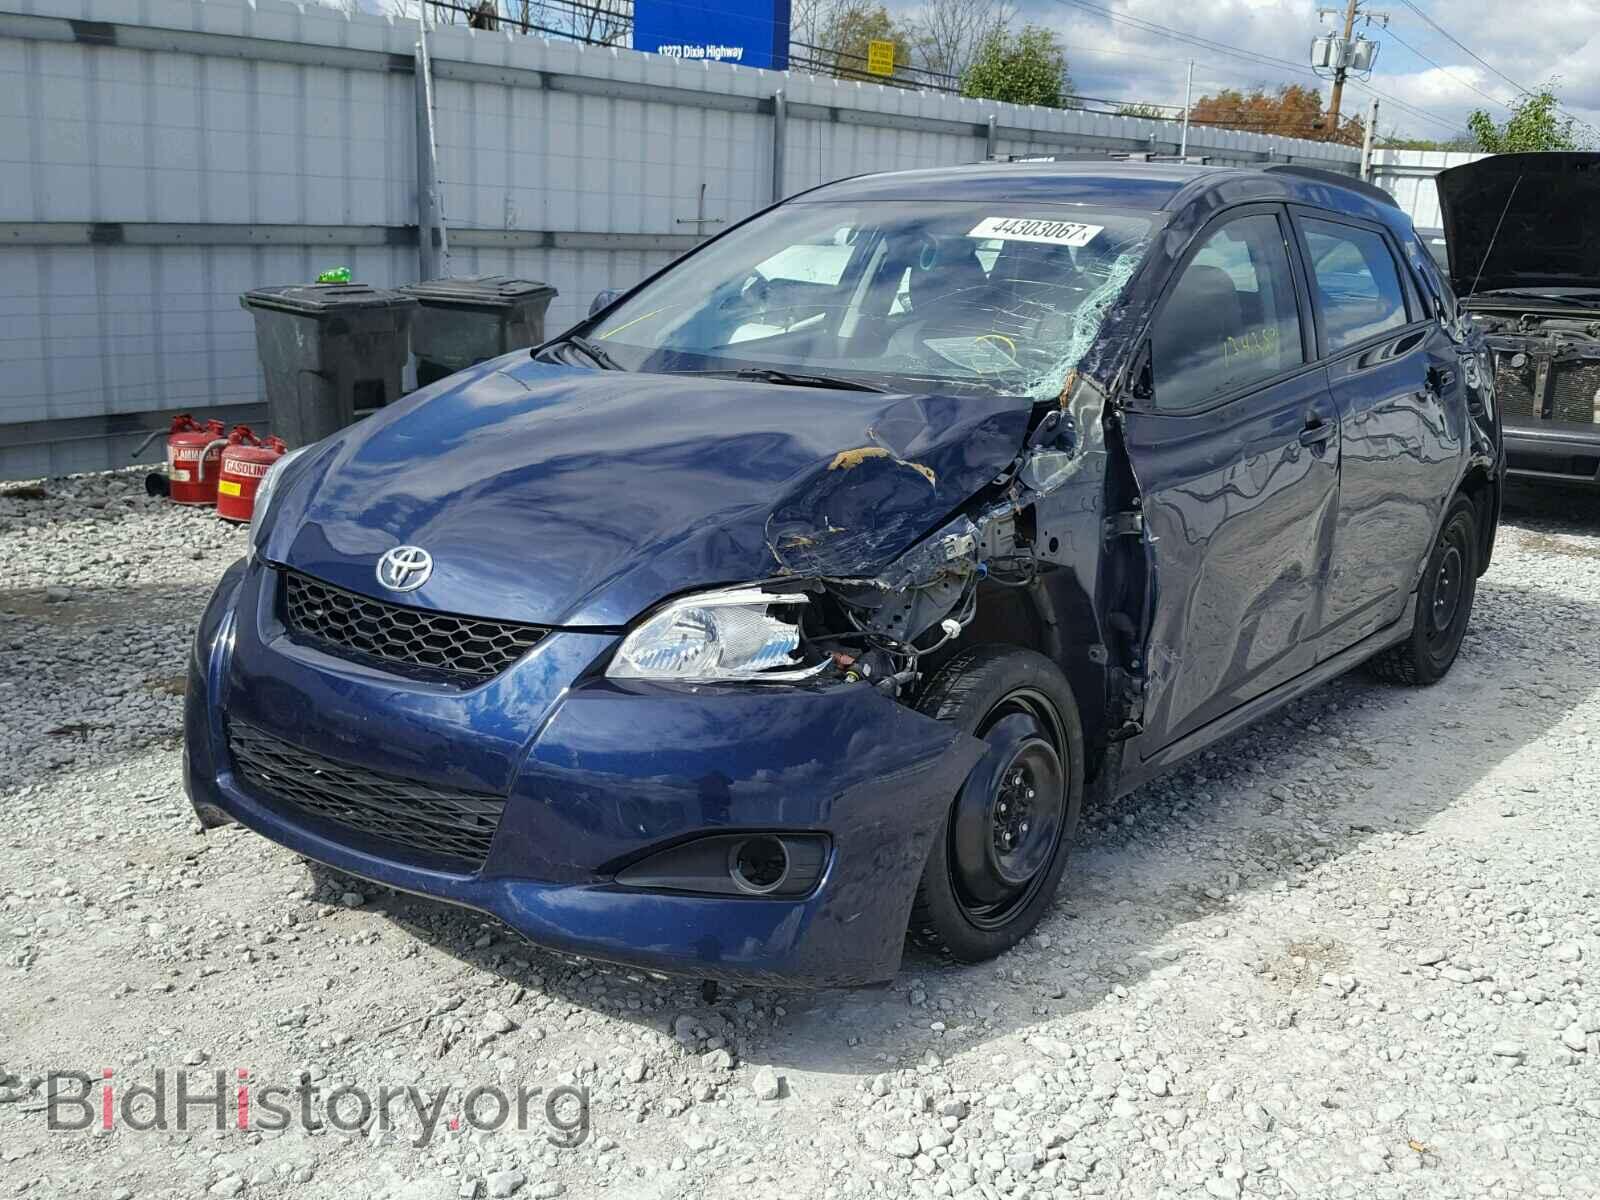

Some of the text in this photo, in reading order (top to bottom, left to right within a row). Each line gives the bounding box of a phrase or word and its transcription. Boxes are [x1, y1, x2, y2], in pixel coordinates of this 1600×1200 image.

[683, 44, 705, 58] Dixie
[705, 44, 743, 61] Highway
[992, 218, 1087, 239] 44303067
